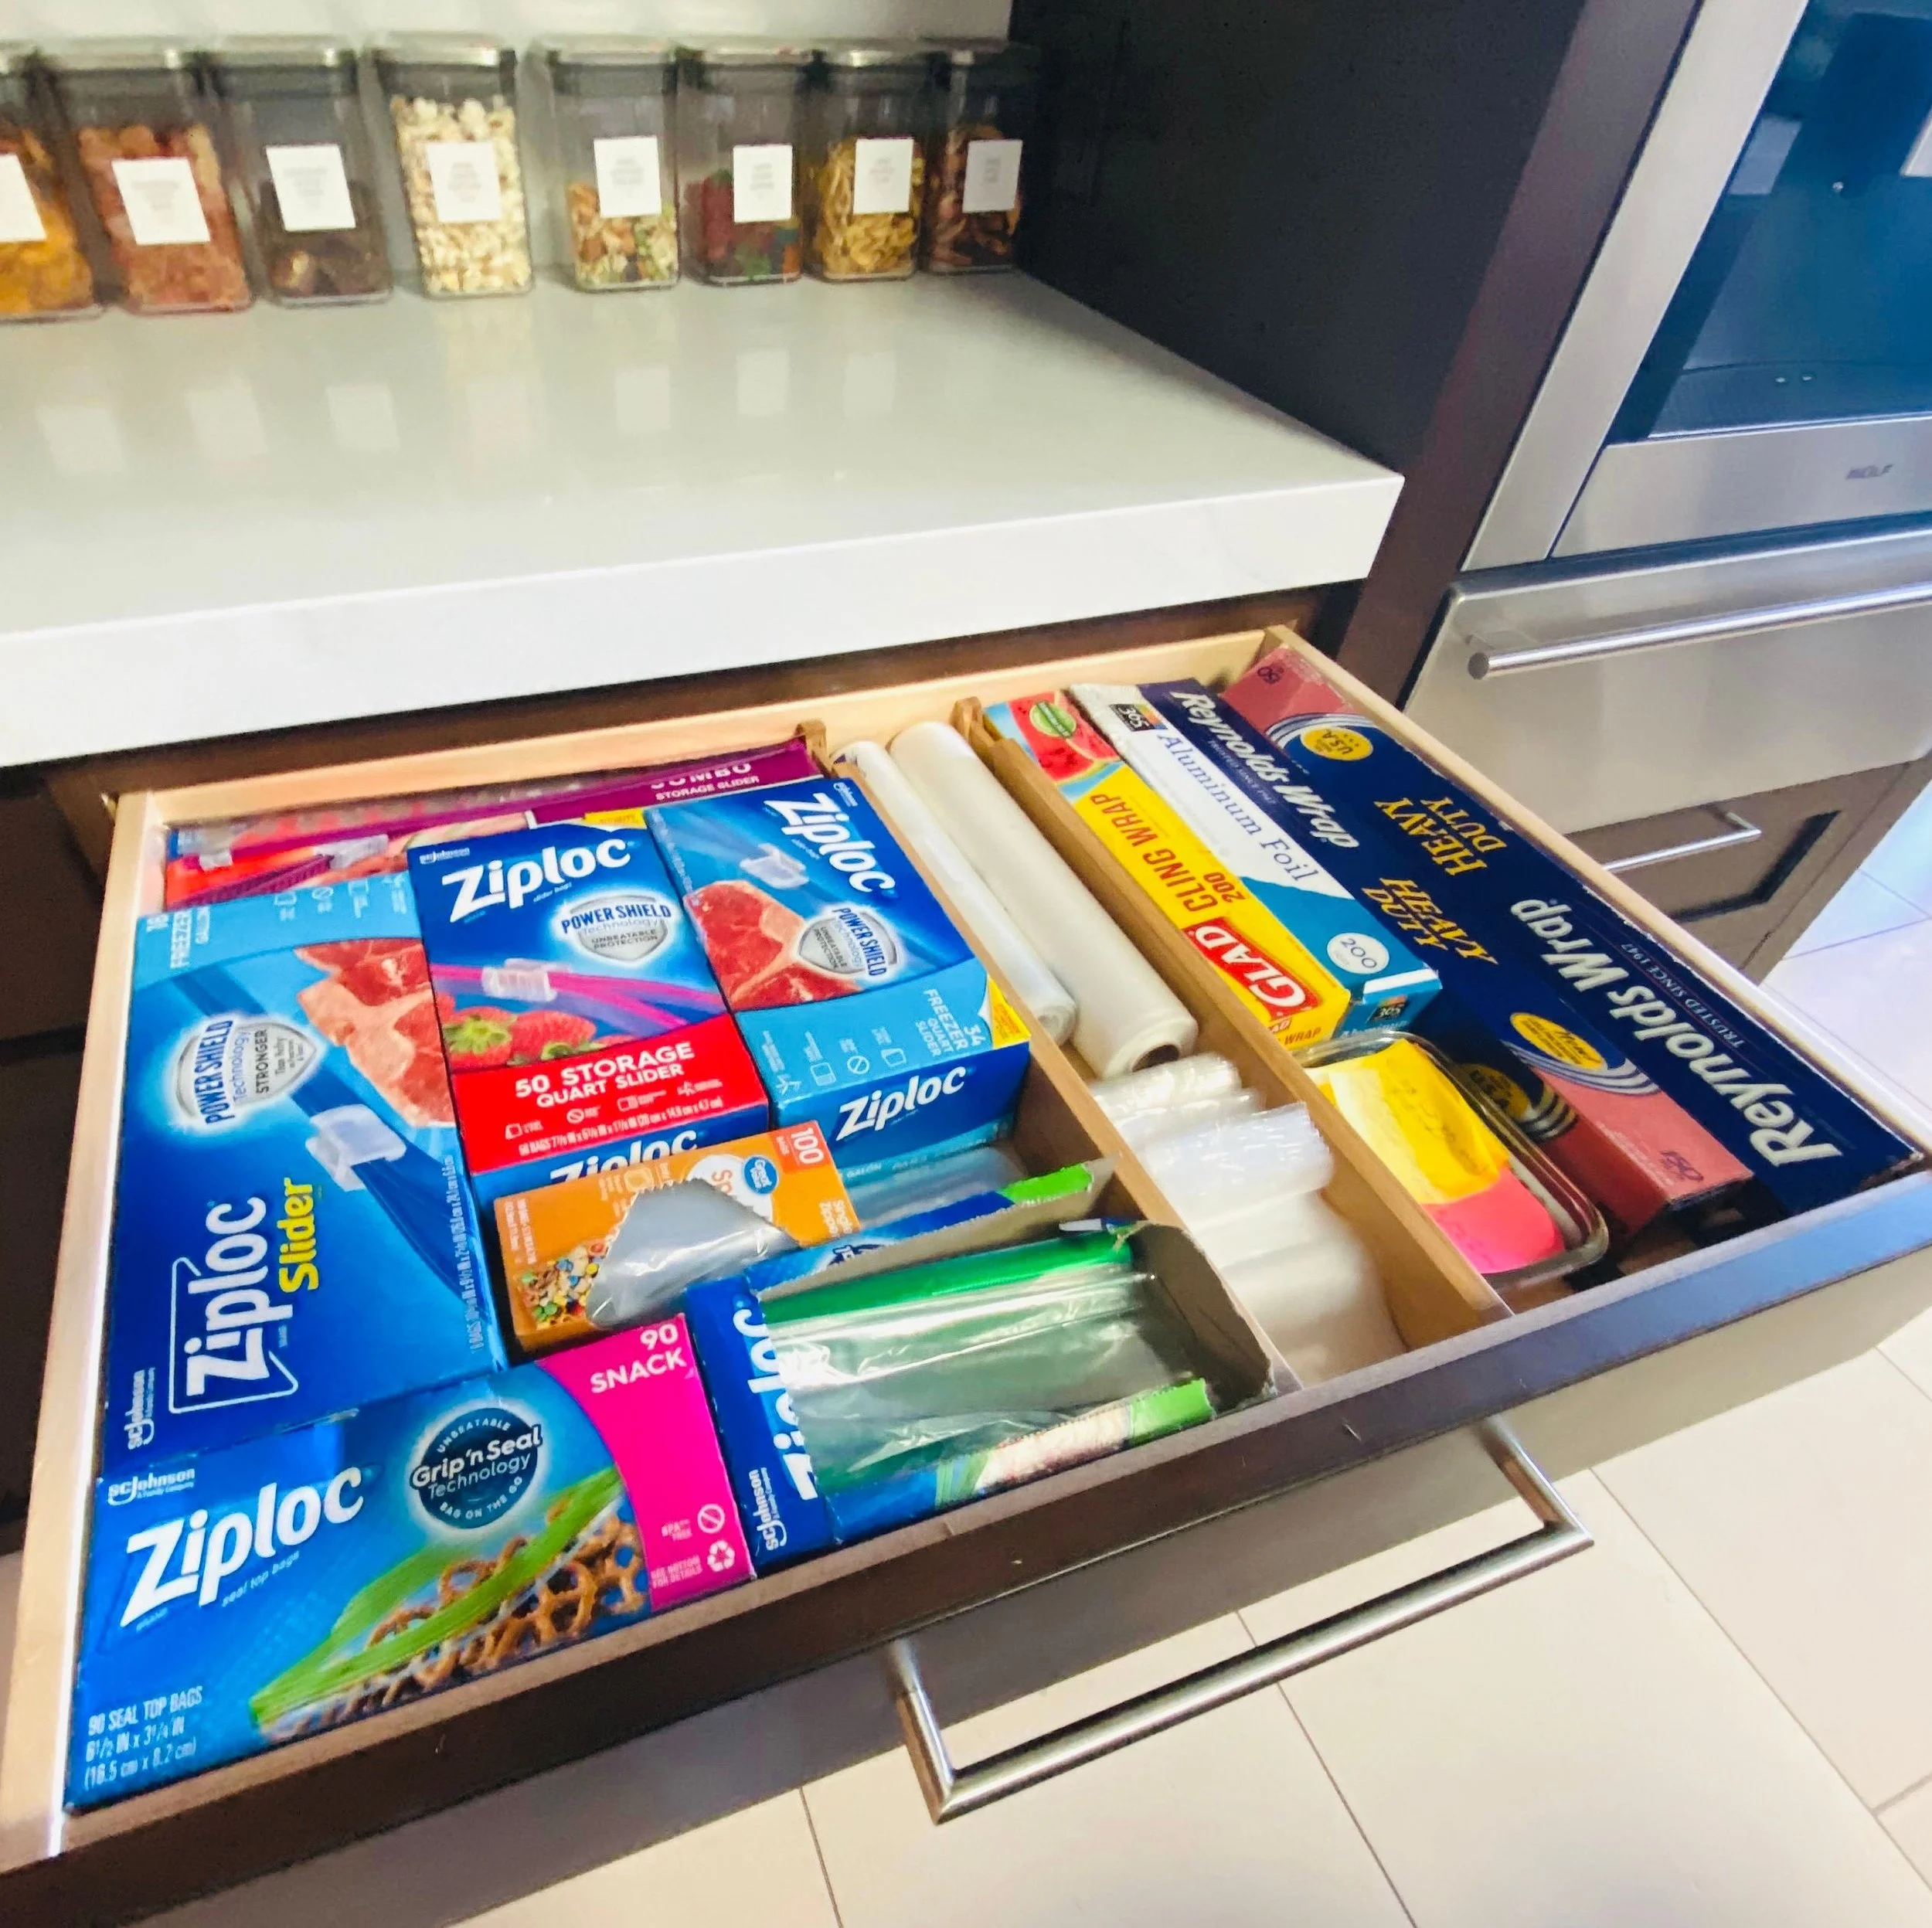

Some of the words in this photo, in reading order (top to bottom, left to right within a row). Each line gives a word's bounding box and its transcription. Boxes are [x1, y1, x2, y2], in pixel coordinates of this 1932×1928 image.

[655, 783, 716, 801] STORAGE
[716, 775, 760, 791] SLIDER
[1168, 691, 1291, 784] Reynolds
[1273, 784, 1361, 849] Wrap
[1090, 793, 1158, 847] WRAP
[1155, 733, 1263, 838] Aluminum
[1260, 838, 1321, 882] Foil
[1419, 796, 1509, 854] DUTY
[763, 791, 896, 894] Ziploc
[1373, 797, 1488, 877] HEAVY
[441, 838, 631, 923] Ziploc
[1143, 849, 1218, 914] CLING
[1202, 871, 1247, 903] 200
[561, 906, 615, 934] POWER
[614, 903, 672, 919] SHIELD
[583, 916, 658, 936] Technology
[591, 929, 657, 944] UNBEATABLE
[593, 935, 658, 950] PROTECTION
[831, 906, 874, 944] POWER
[858, 935, 889, 978] SHIELD
[1361, 887, 1449, 953] DUTY
[1379, 876, 1499, 966] HEAVY
[811, 927, 839, 971] PROTECTION
[819, 925, 849, 969] UNBEATABLE
[1194, 924, 1306, 1007] GLAD
[1340, 937, 1377, 968] 200
[1510, 898, 1631, 993] Wrap
[1621, 944, 1651, 965] 1947
[1647, 965, 1689, 998] SINCE
[915, 1020, 942, 1058] SLIDER
[922, 988, 969, 1051] FREEZER
[927, 1017, 955, 1052] QUART
[963, 1024, 987, 1047] 34
[1284, 1026, 1321, 1046] WRAP
[1684, 998, 1747, 1049] TRUSTED
[195, 1020, 234, 1073] SHIELD
[229, 1030, 251, 1103] Technology
[253, 1029, 270, 1094] STRONGER
[515, 1074, 551, 1098] 50
[560, 1041, 696, 1089] STORAGE
[193, 1071, 236, 1125] POWER
[536, 1080, 608, 1109] QUART
[616, 1063, 685, 1090] SLIDER
[1607, 984, 1845, 1168] Reynolds
[835, 1065, 967, 1142] Ziploc
[789, 1127, 825, 1167] 100
[276, 1177, 319, 1293] Slider
[183, 1196, 294, 1397] Ziploc
[638, 1322, 679, 1351] 90
[589, 1347, 688, 1395] SNACK
[412, 1457, 465, 1488] Grip
[486, 1426, 541, 1461] Seal
[437, 1417, 512, 1454] UNBEATABLE
[427, 1453, 532, 1501] Technology
[438, 1501, 462, 1519] BAG
[465, 1508, 483, 1520] ON
[487, 1494, 509, 1512] THE
[508, 1476, 523, 1494] GO
[119, 1466, 365, 1628] Ziploc
[222, 1581, 249, 1608] seal
[250, 1570, 269, 1590] top
[271, 1549, 301, 1575] bags
[88, 1712, 106, 1736] 90
[107, 1704, 139, 1732] SEAL
[142, 1696, 168, 1721] TOP
[169, 1685, 203, 1713] BAGS
[133, 1734, 141, 1748] x
[141, 1756, 149, 1770] x
